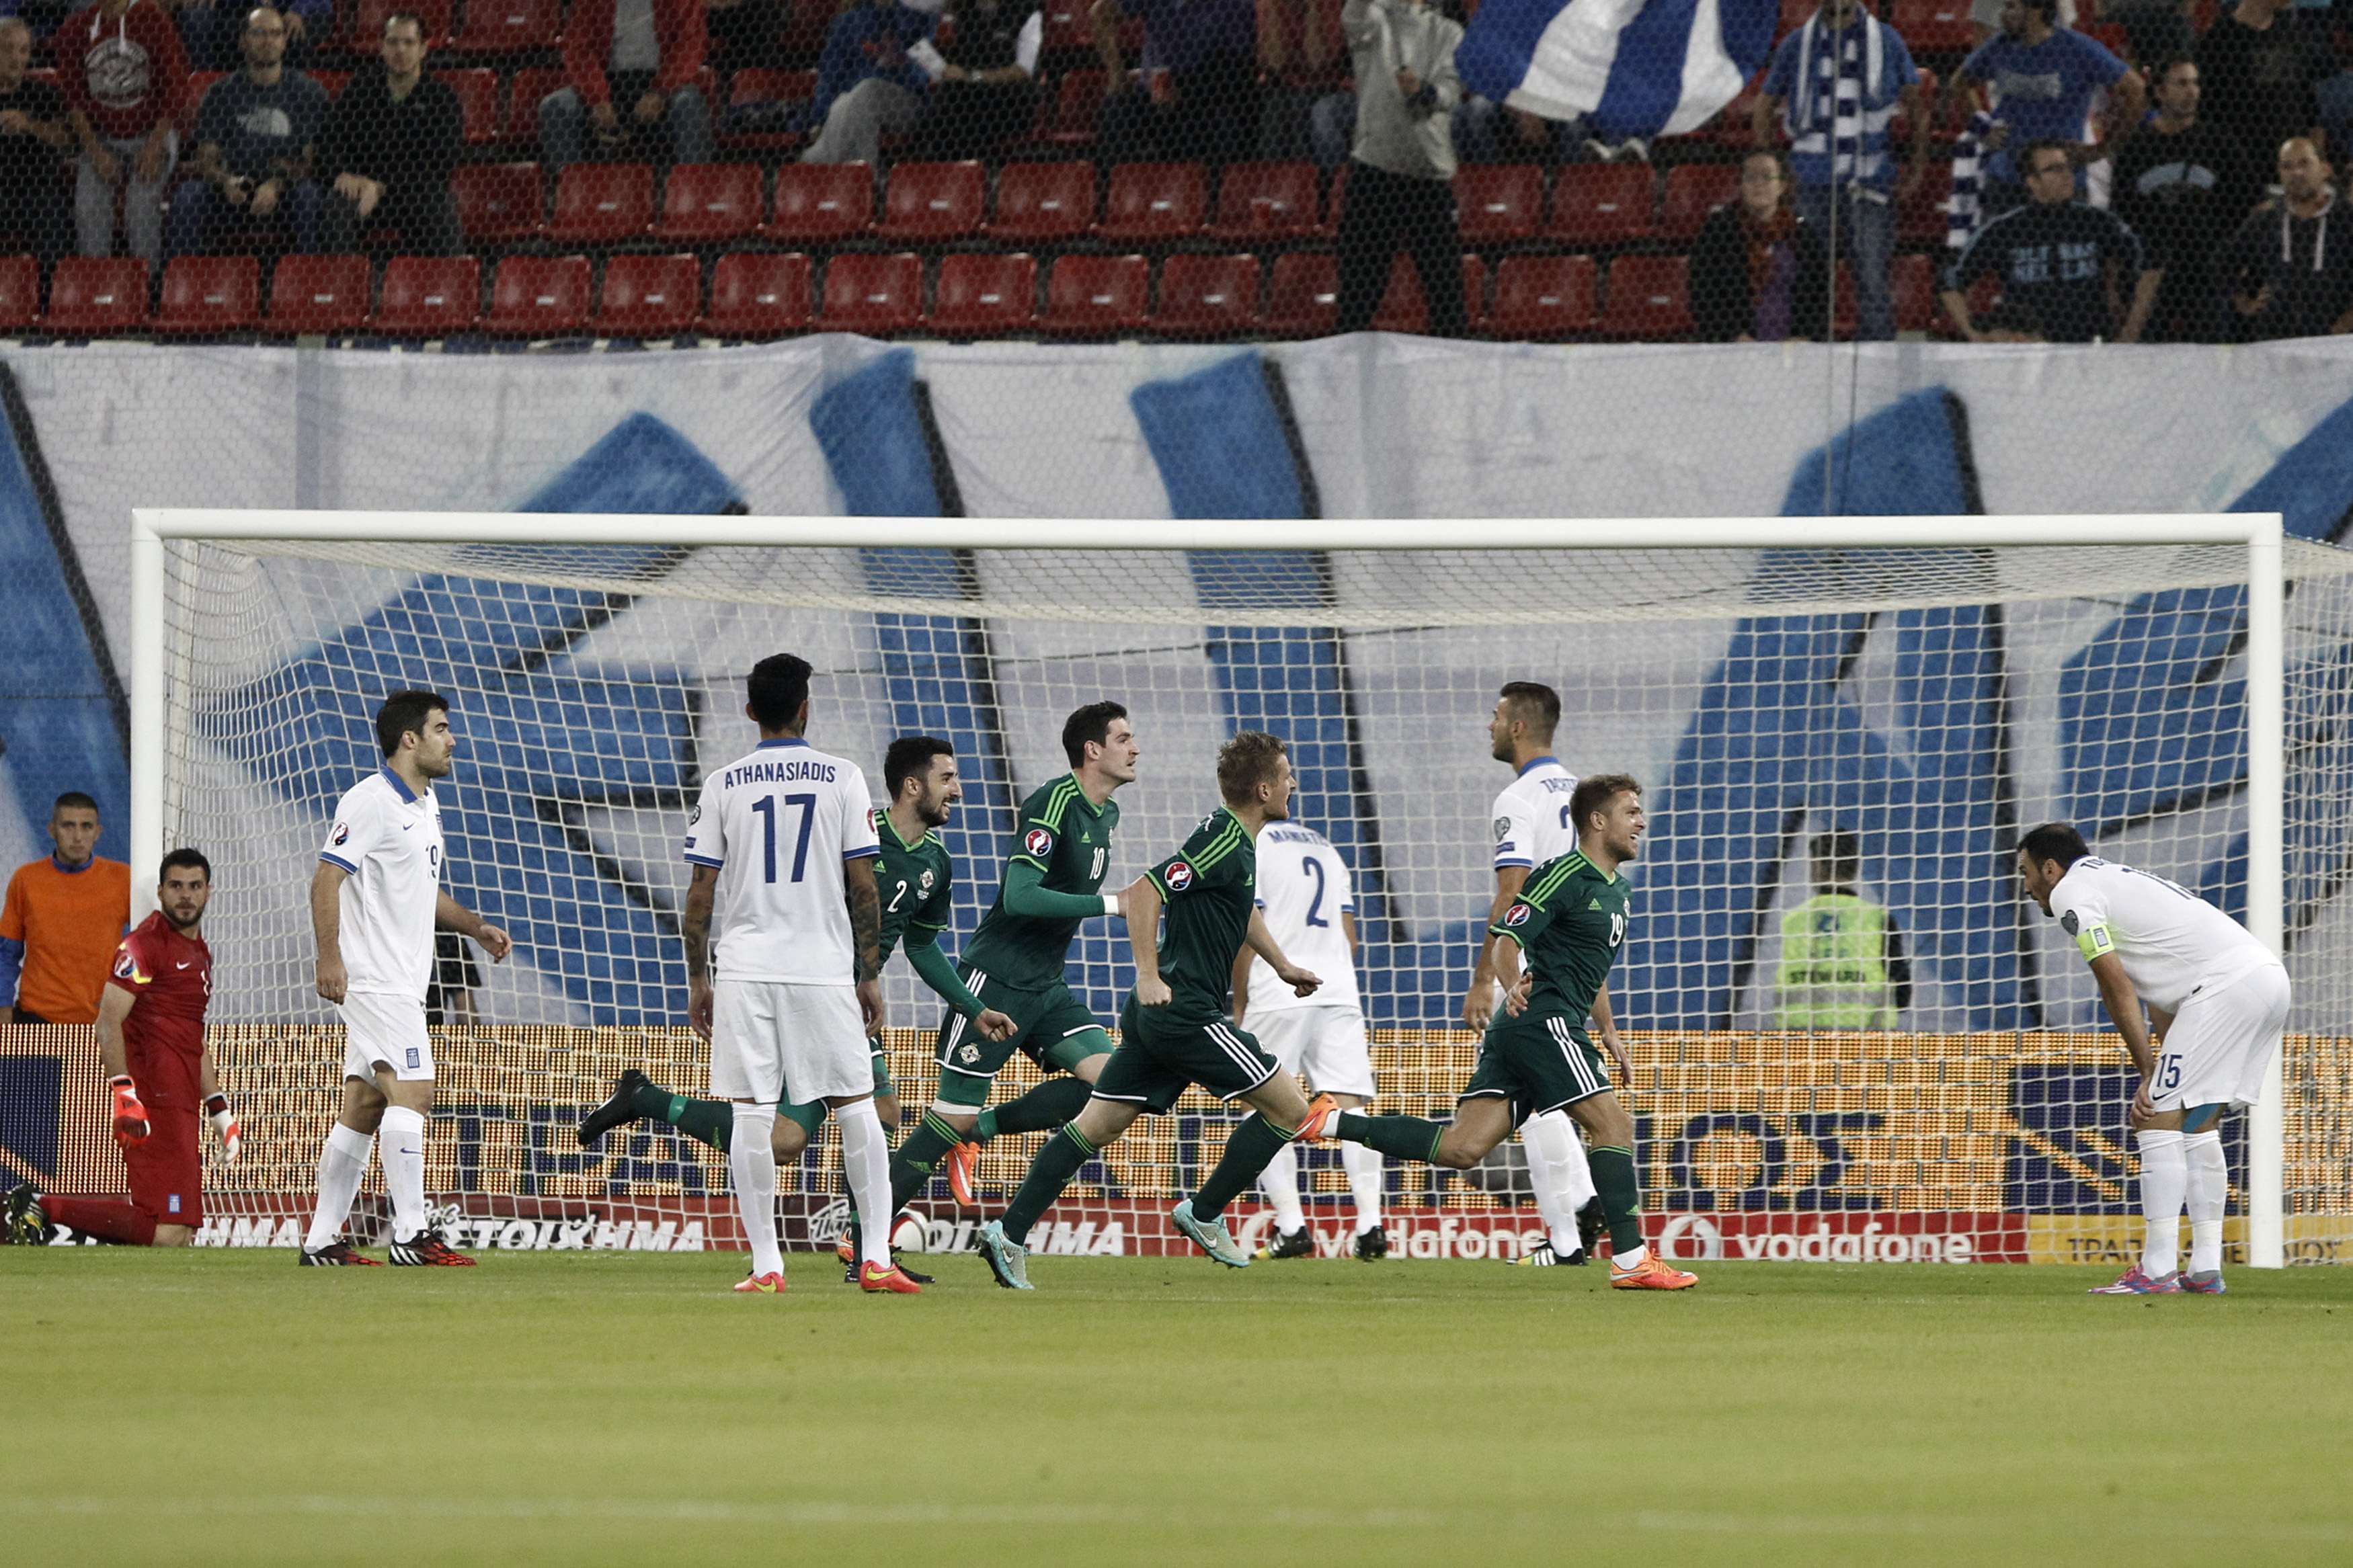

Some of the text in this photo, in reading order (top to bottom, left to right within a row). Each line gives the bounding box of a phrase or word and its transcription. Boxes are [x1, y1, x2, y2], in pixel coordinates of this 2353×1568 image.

[725, 761, 836, 790] ATHANASIADIS
[752, 793, 816, 883] 17
[1089, 847, 1105, 880] 10
[887, 880, 908, 913] 2
[1302, 856, 1328, 927] 2
[1609, 913, 1624, 947] 19
[2156, 1054, 2183, 1088] 15
[1737, 1222, 1972, 1263] vodafone
